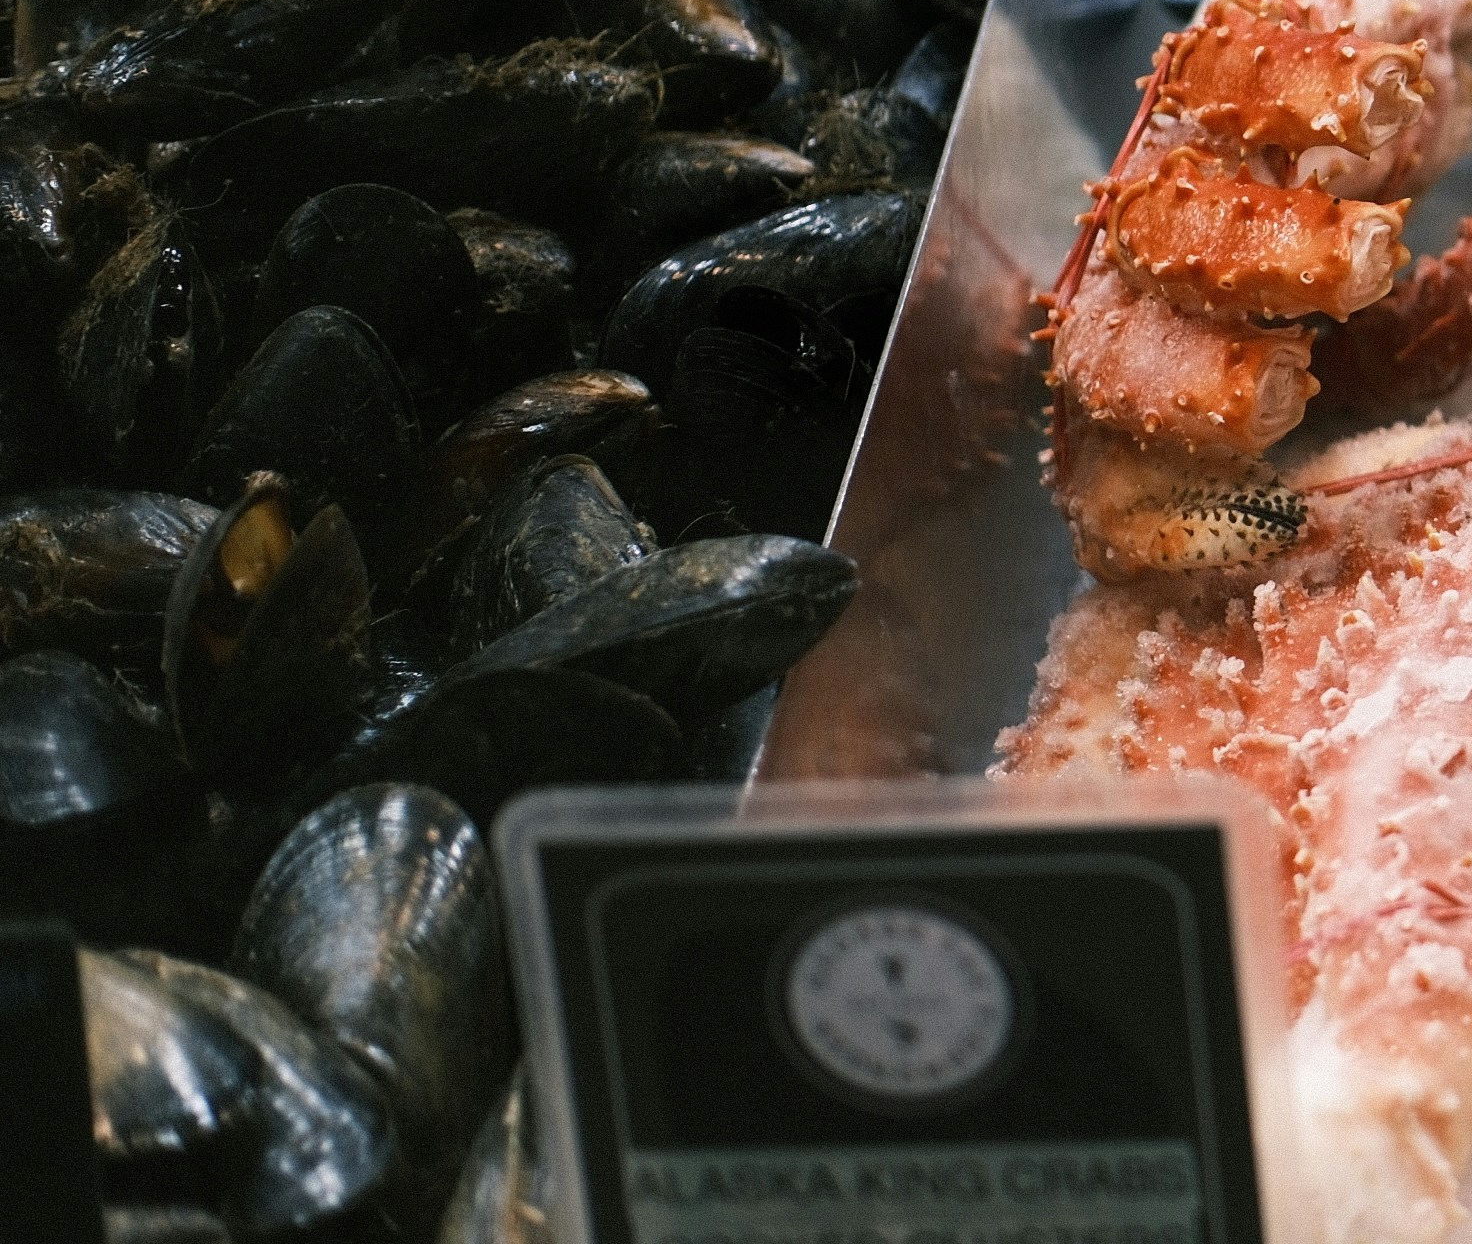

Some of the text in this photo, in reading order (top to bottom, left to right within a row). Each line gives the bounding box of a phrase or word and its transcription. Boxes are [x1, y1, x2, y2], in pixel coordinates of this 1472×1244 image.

[632, 1155, 1189, 1205] ALASKA KING CRABS
